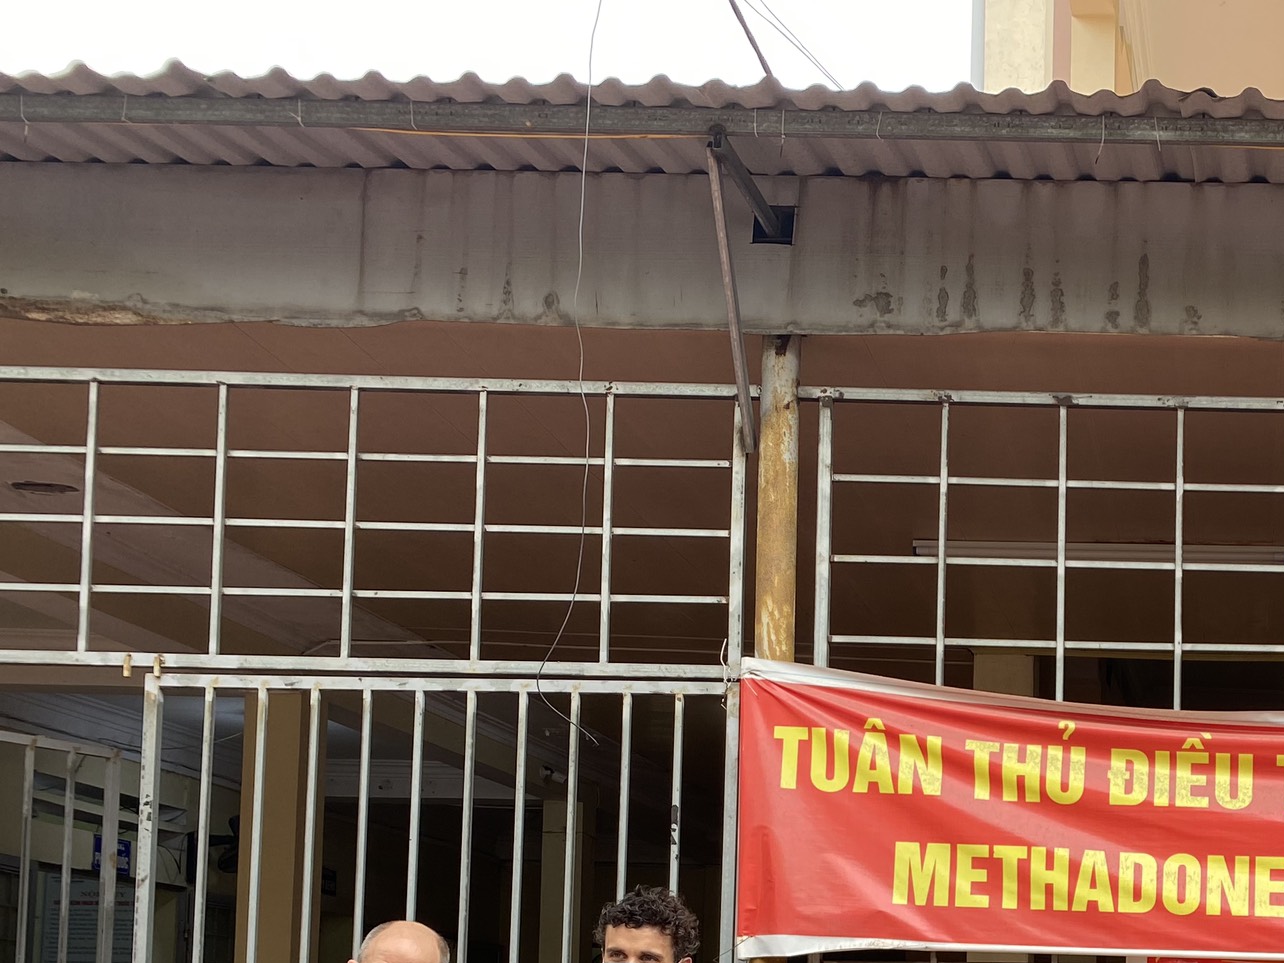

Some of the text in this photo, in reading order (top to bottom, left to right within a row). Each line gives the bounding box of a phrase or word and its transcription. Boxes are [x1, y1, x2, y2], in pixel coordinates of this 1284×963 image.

[774, 717, 943, 796] TUÂN
[965, 720, 1086, 805] THỦ
[1107, 732, 1254, 810] ĐIỀU
